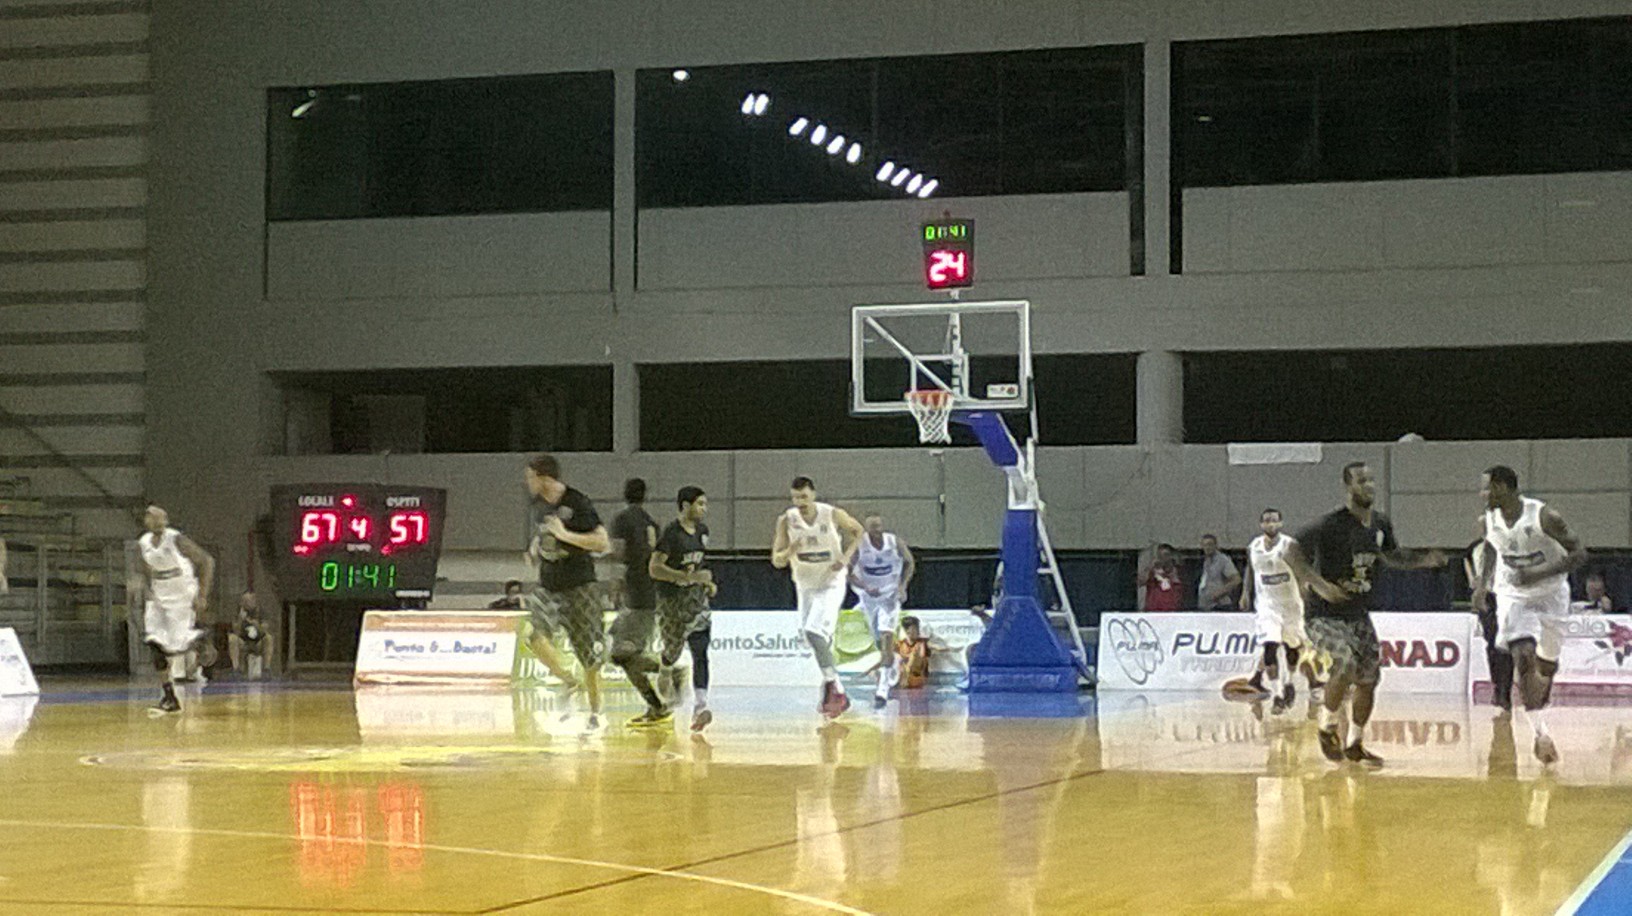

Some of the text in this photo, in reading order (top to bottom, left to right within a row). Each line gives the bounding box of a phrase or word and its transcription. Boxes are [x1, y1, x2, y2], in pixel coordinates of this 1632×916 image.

[930, 251, 965, 282] 24
[301, 512, 336, 542] 67
[351, 517, 367, 539] 4
[390, 514, 424, 543] 57
[321, 562, 396, 590] 01:41
[1379, 640, 1460, 667] NAD
